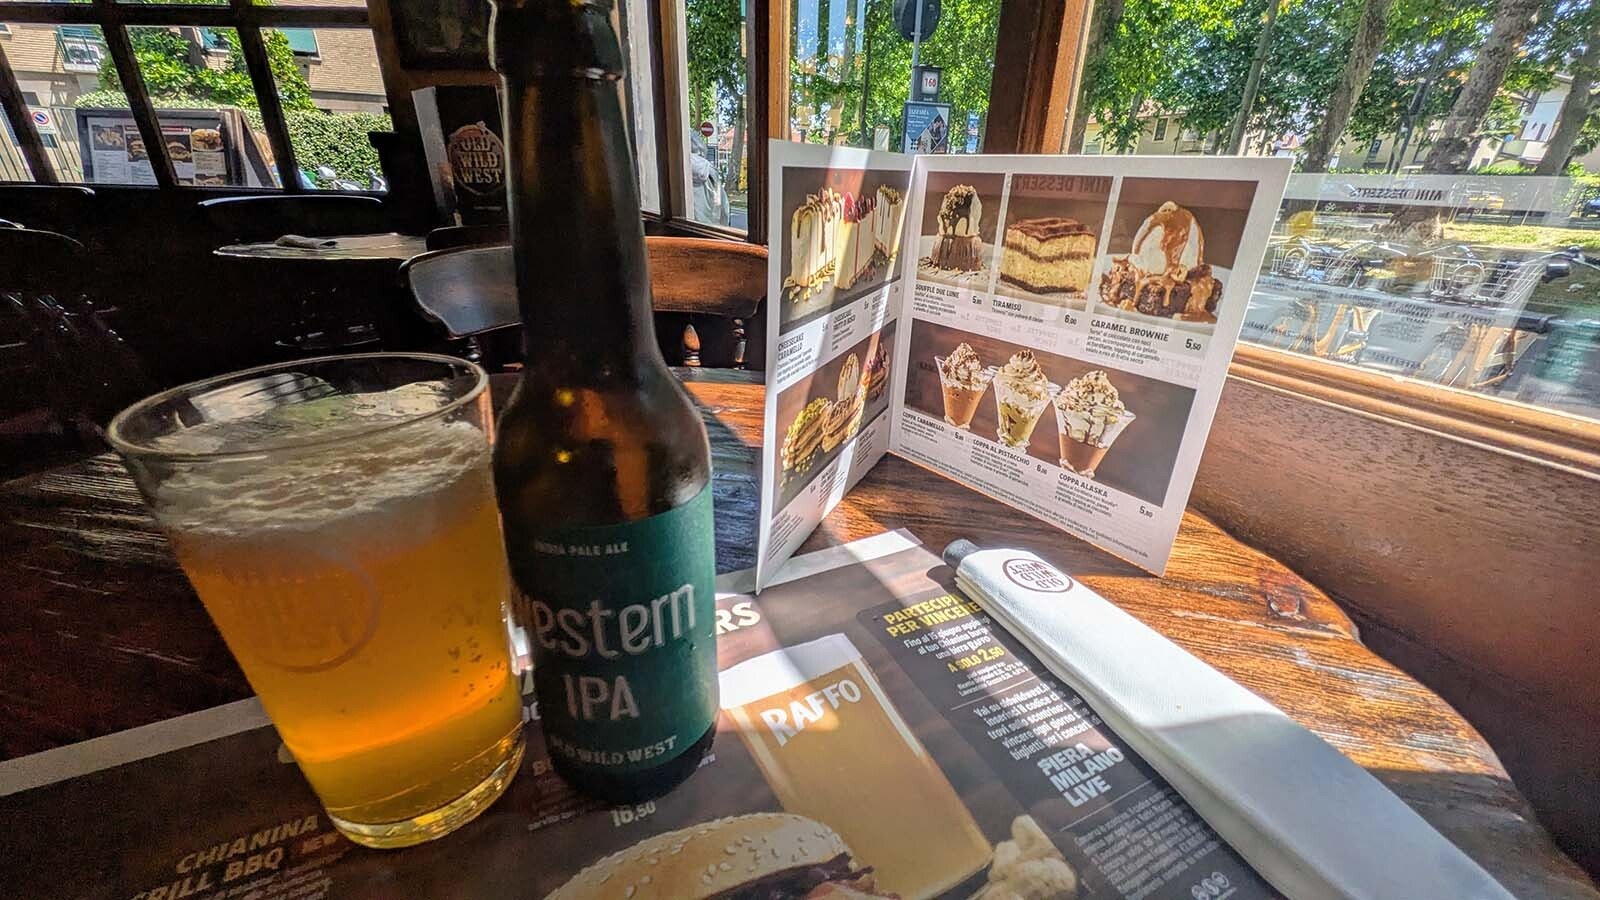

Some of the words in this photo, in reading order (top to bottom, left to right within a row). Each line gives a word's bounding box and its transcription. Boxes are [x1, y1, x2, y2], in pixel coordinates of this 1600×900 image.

[461, 138, 491, 151] OLD
[461, 151, 498, 168] WILD
[461, 168, 502, 183] WEST
[935, 287, 946, 295] DUE
[1090, 318, 1128, 334] CARAMEL
[1129, 326, 1169, 342] BROWNIE
[1185, 338, 1202, 351] 5,50
[989, 445, 998, 453] AL
[997, 447, 1030, 466] PISTACCHIO
[1058, 472, 1080, 486] COPPA
[1079, 481, 1109, 497] ALASKA
[604, 541, 629, 555] ALE
[528, 583, 697, 660] estern
[715, 602, 760, 635] RS
[883, 594, 965, 625] PARTECIPA
[886, 621, 921, 638] PER
[920, 602, 983, 628] VINCERE
[903, 636, 922, 649] Fino
[928, 631, 937, 641] 15
[926, 642, 940, 653] tuo
[940, 634, 970, 650] Chianina
[936, 651, 951, 660] una
[950, 642, 967, 656] birra
[947, 662, 958, 673] A
[958, 655, 979, 671] SOLO
[978, 646, 1005, 662] 2,50
[562, 673, 640, 721] IPA
[973, 704, 990, 717] Vai
[990, 703, 1000, 711] su
[1025, 695, 1051, 711] codice
[760, 679, 861, 747] RAFFO
[987, 725, 1009, 739] trovi
[1001, 728, 1033, 747] vincere
[1032, 722, 1051, 737] ogni
[1049, 712, 1075, 730] giorno
[575, 745, 624, 766] WILD
[626, 734, 677, 761] WEST
[1010, 740, 1045, 761] biglietti
[1042, 734, 1058, 747] per
[1037, 742, 1095, 776] FIERA
[1050, 747, 1125, 792] MILANO
[1063, 775, 1112, 807] LIVE
[176, 815, 319, 874] CHIANINA
[223, 846, 285, 882] BBQ
